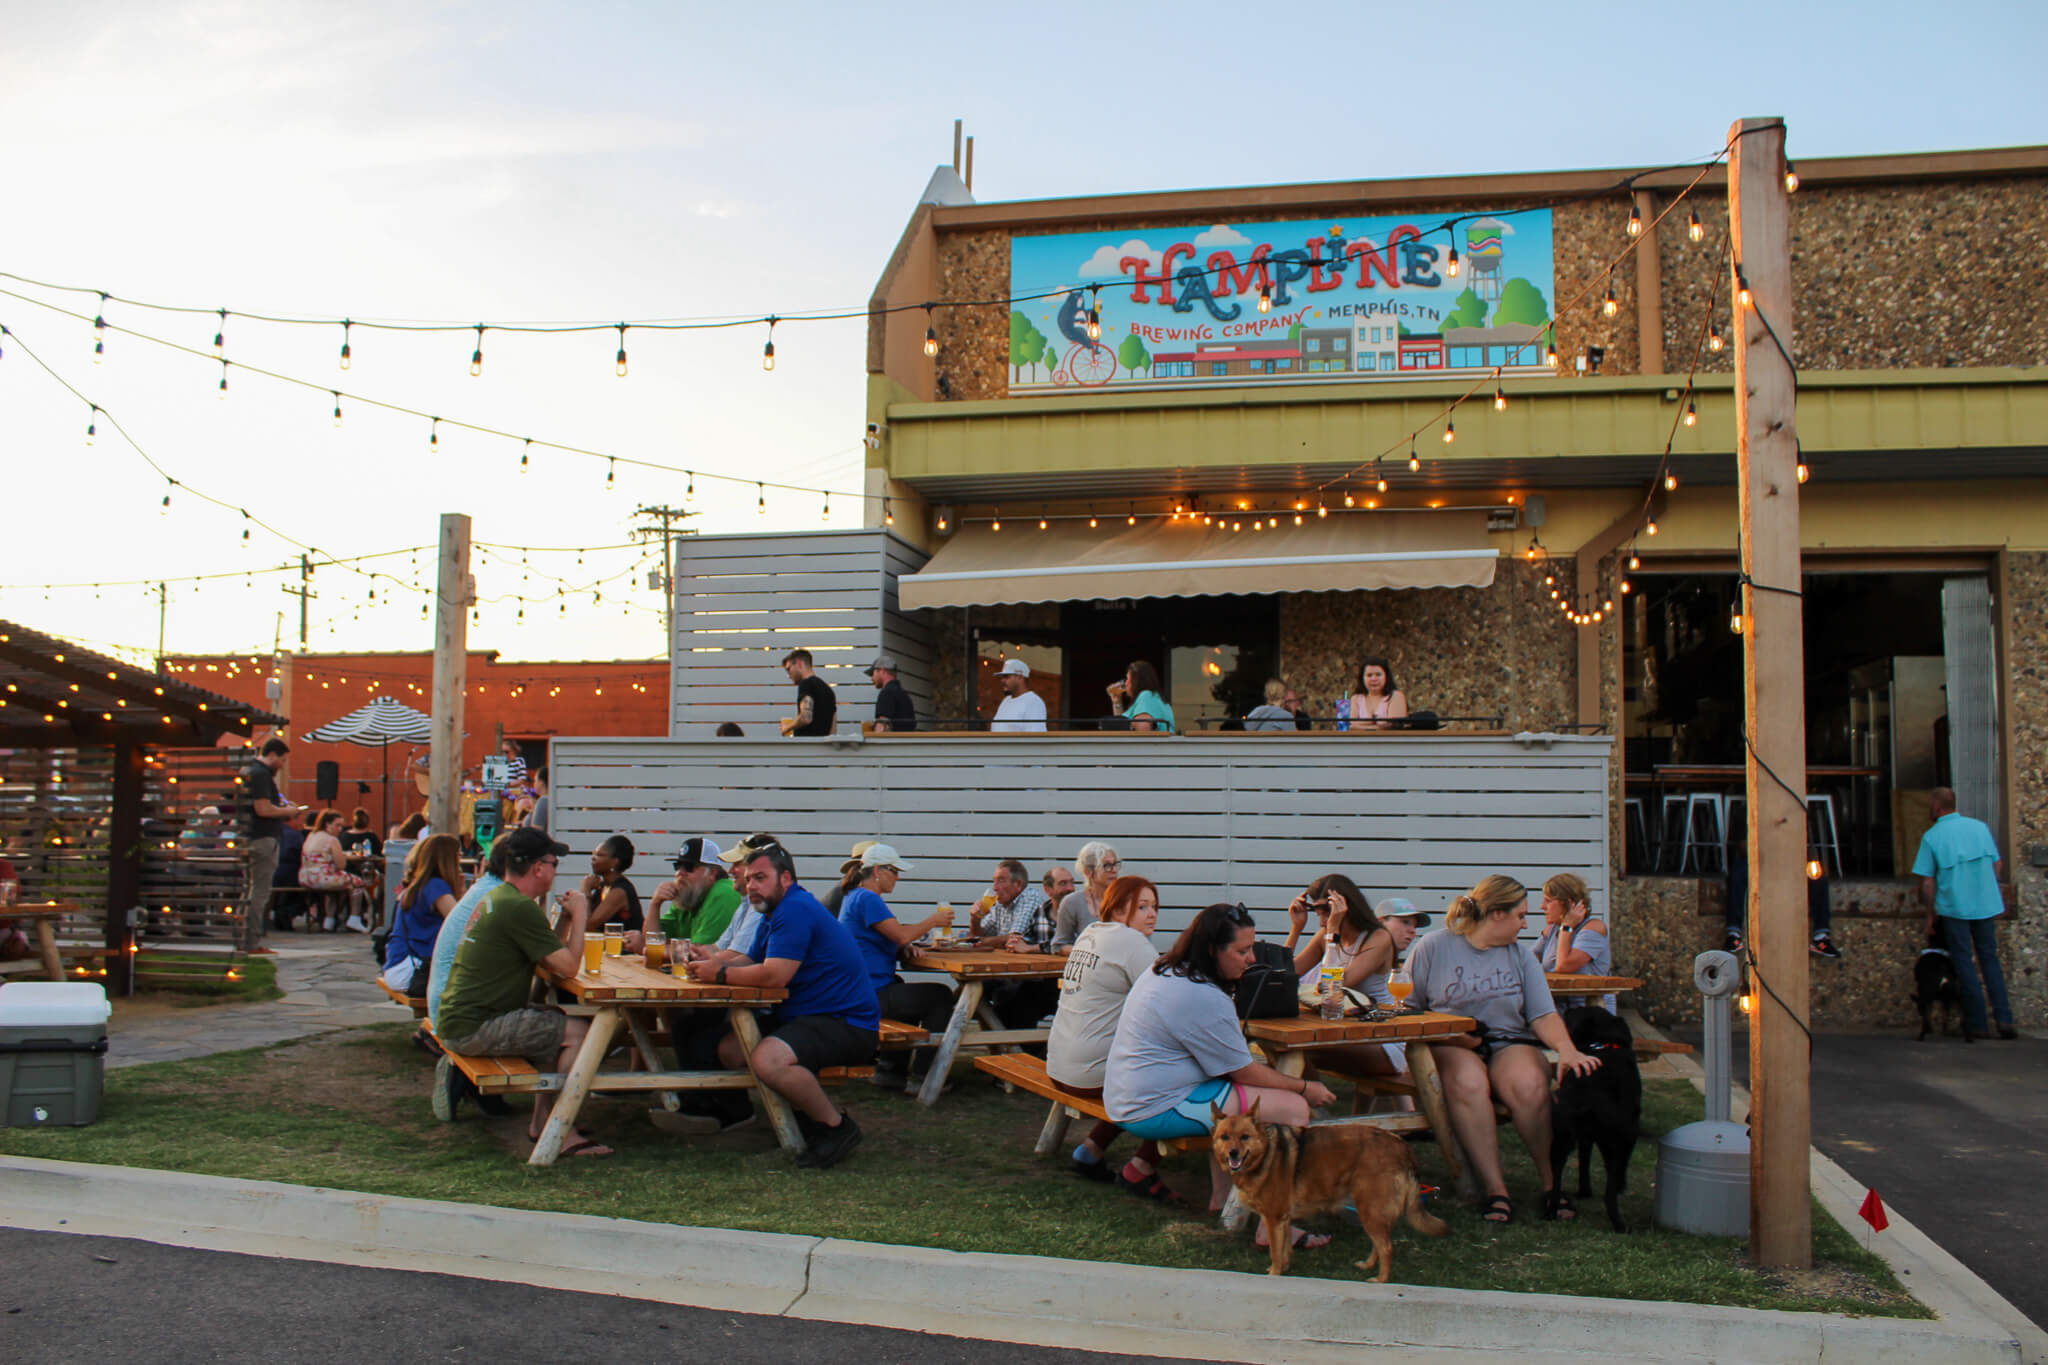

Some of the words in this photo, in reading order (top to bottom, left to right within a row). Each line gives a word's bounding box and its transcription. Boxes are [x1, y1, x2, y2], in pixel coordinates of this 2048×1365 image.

[1120, 224, 1442, 321] HAMPLINE
[1130, 322, 1213, 343] BREWING
[1222, 305, 1313, 337] COMPANY
